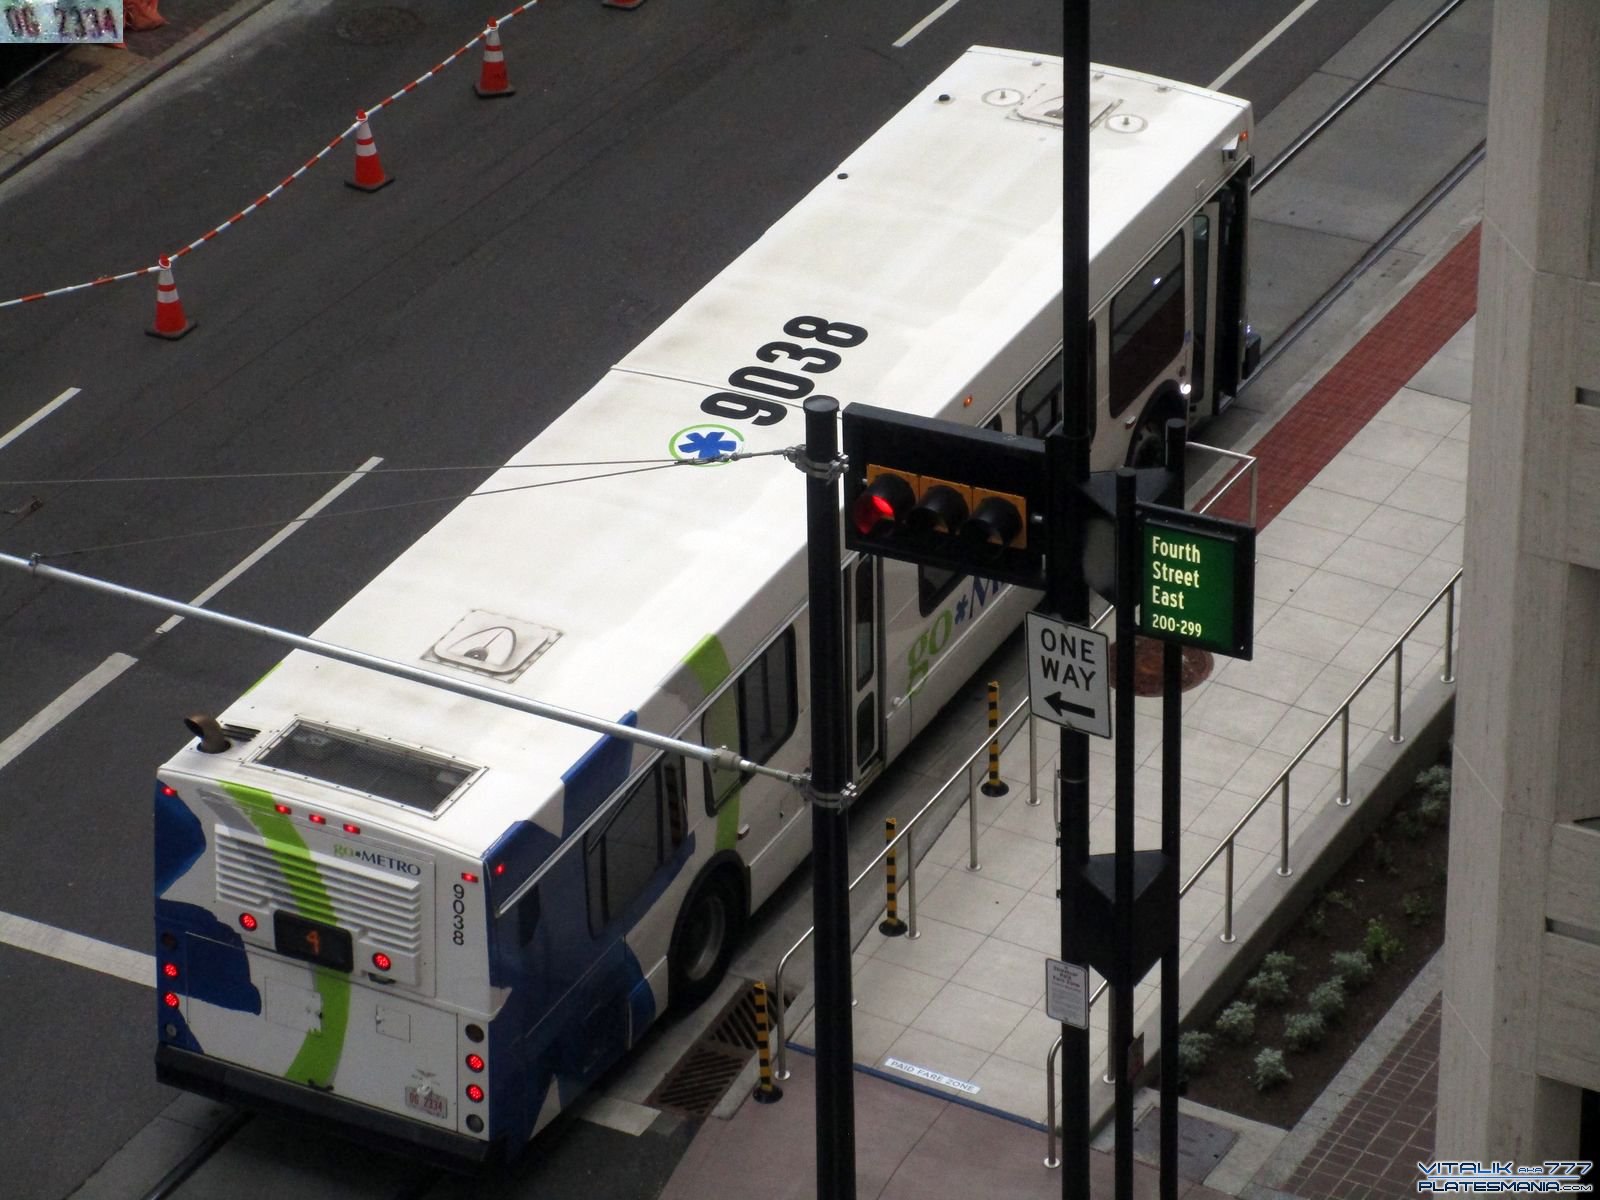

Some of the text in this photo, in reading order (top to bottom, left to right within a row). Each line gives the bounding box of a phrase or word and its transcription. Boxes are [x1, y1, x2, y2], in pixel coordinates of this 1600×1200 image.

[700, 315, 868, 426] 9038
[1152, 536, 1200, 564] Fourth
[1152, 561, 1200, 588] Street
[1152, 585, 1185, 609] East
[1152, 613, 1202, 637] 200-299
[907, 608, 953, 697] go
[1041, 628, 1095, 664] ONE
[1041, 655, 1096, 691] WAY
[452, 883, 465, 946] 9038
[890, 1060, 976, 1092] PAID FARE ZONE
